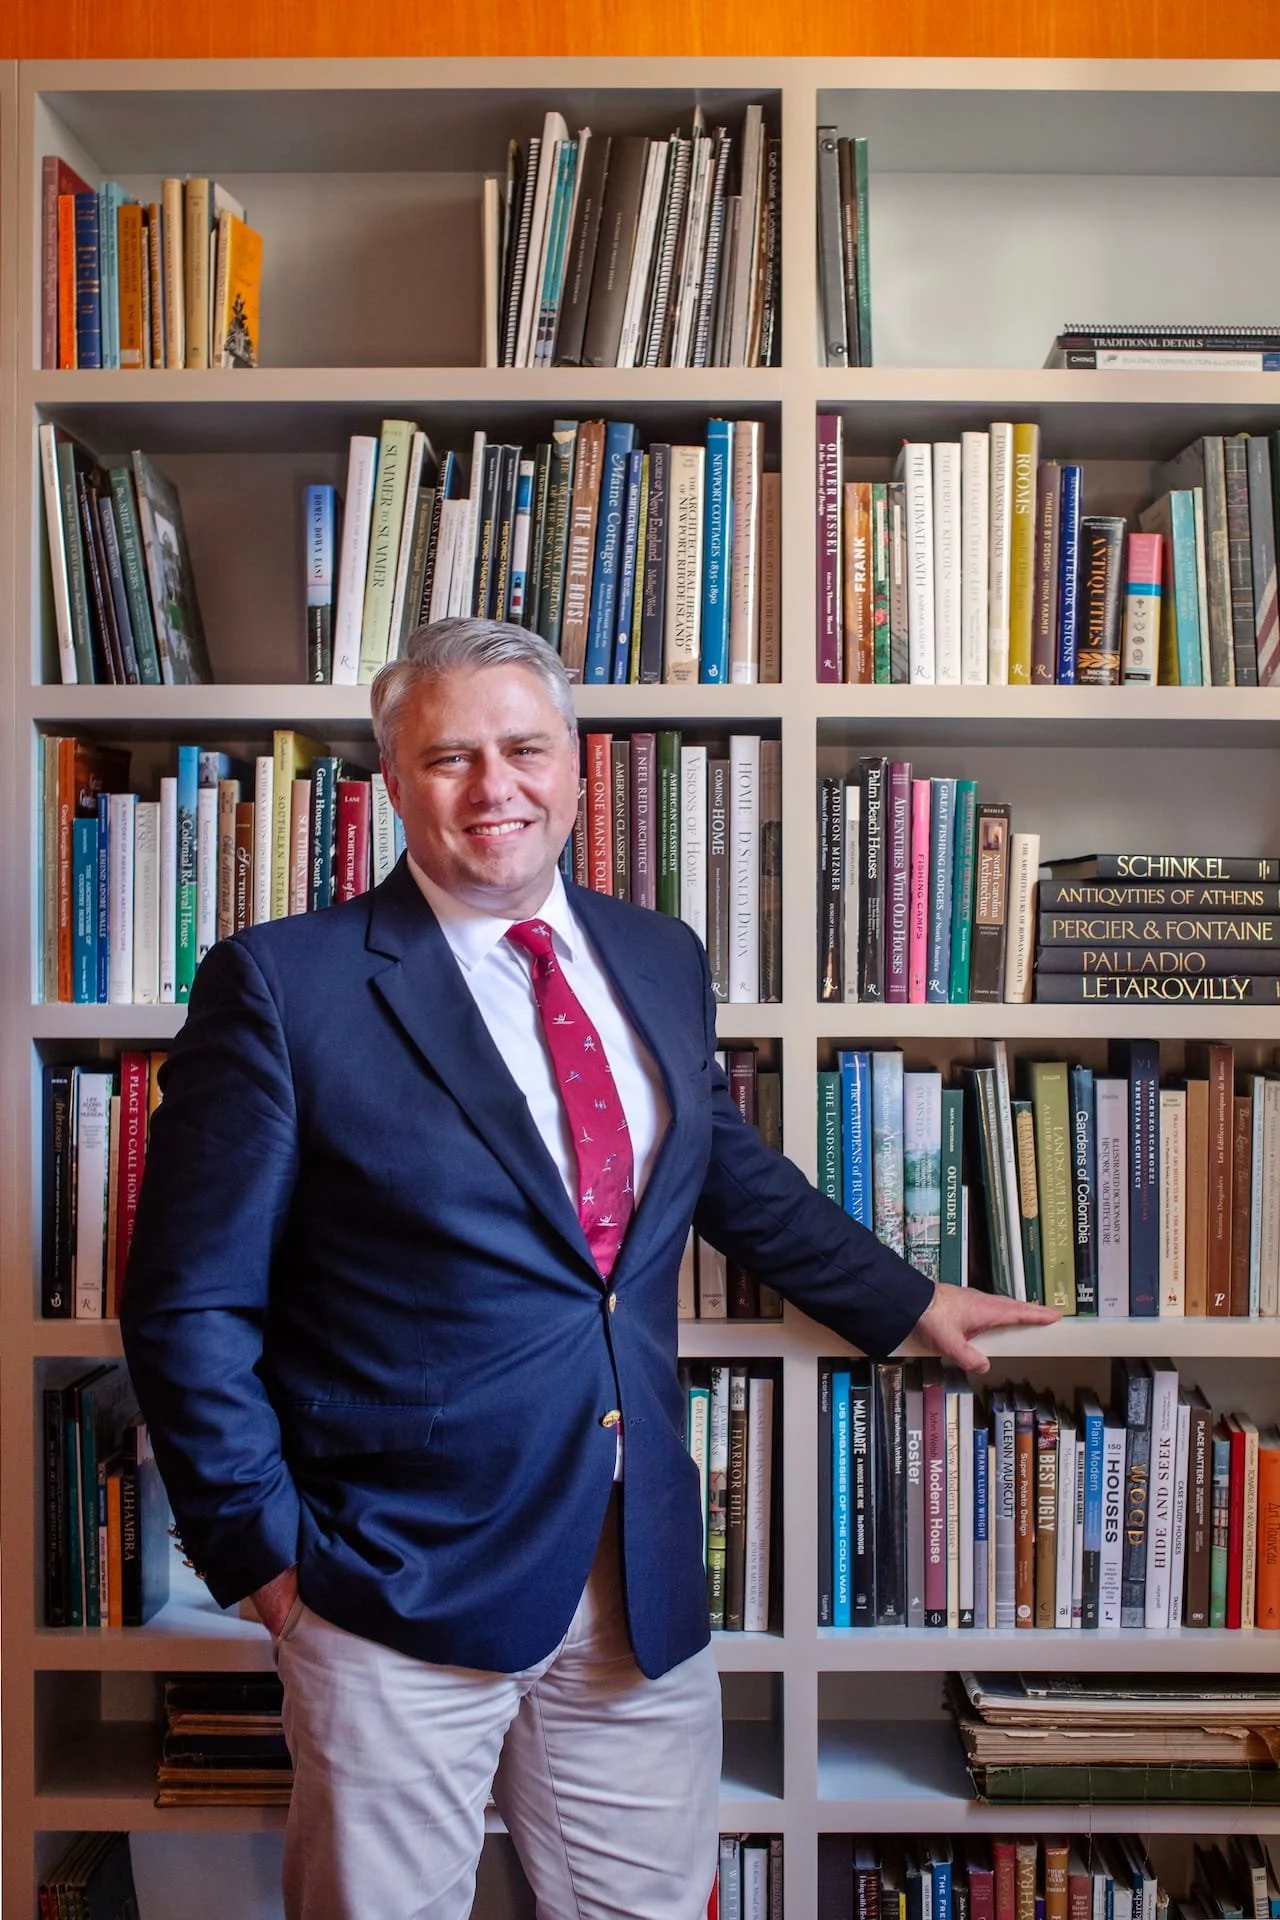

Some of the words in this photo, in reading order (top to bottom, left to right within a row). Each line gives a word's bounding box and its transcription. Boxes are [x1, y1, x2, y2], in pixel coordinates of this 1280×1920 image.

[1092, 338, 1160, 347] TRADITIONAL
[1162, 339, 1204, 348] DETAILS
[380, 444, 397, 506] SUMMER
[608, 453, 626, 506] Maine
[712, 454, 722, 502] NEWPORT
[826, 444, 837, 496] OLIVER
[1016, 453, 1031, 514] ROOMS
[314, 494, 324, 522] HOMES
[574, 506, 592, 528] THE
[1044, 492, 1052, 527] TIMELESS
[314, 527, 323, 553] DOWN
[501, 520, 510, 558] HISTORIC
[600, 512, 619, 574] Cottages
[677, 498, 688, 558] NEWPORT,
[687, 494, 698, 593] ARCHITECTURAL
[710, 504, 721, 556] COTTAGES
[826, 503, 837, 556] MESSEL
[1044, 530, 1052, 541] BY
[314, 558, 322, 579] EAST
[372, 525, 391, 587] SUMMER
[498, 560, 507, 589] MAINE
[571, 536, 590, 576] MAINE
[854, 537, 865, 592] FRANK
[1043, 543, 1051, 572] DESIGN
[1064, 540, 1076, 605] INTERIOR
[677, 559, 686, 600] RHODE
[710, 560, 719, 604] 1835-1890
[1041, 579, 1050, 601] NINA
[1087, 538, 1106, 645] ANTIQUITIES
[566, 584, 585, 624] HOUSE
[675, 603, 685, 647] ISLAND
[685, 596, 695, 653] HERITAGE
[1063, 609, 1075, 662] VISIONS
[316, 768, 326, 797] Great
[616, 762, 624, 817] AMERICAN
[638, 757, 647, 785] NEEL
[714, 769, 723, 806] COMING
[737, 762, 752, 813] HOME
[867, 769, 880, 799] Palm
[594, 782, 605, 811] ONE
[637, 788, 647, 815] REID,
[832, 787, 840, 841] ADDISON
[939, 786, 948, 819] GREAT
[315, 800, 325, 836] Houses
[594, 815, 605, 856] MAN'S
[712, 809, 725, 855] HOME
[739, 832, 752, 843] D.
[868, 801, 880, 835] Beach
[893, 796, 906, 867] ADVENTURES
[181, 820, 192, 866] Colonial
[616, 819, 625, 875] CLASSICIST
[868, 837, 880, 878] Houses
[938, 824, 947, 866] FISHING
[313, 858, 324, 887] South
[738, 845, 751, 906] STANLEY
[831, 846, 840, 891] MIZNER
[893, 872, 906, 901] WITH
[980, 854, 992, 916] Architecture
[992, 854, 1002, 880] North
[1117, 856, 1230, 879] SCHINKEL
[181, 870, 192, 909] Revival
[936, 868, 945, 910] LODGES
[1057, 888, 1164, 905] ANTIQVITIES
[1171, 890, 1194, 904] OF
[1200, 890, 1263, 905] ATHENS
[180, 912, 191, 947] House
[893, 903, 906, 927] OLD
[1053, 920, 1140, 939] PERCIER
[1144, 921, 1162, 939] &
[1166, 921, 1273, 941] FONTAINE
[737, 912, 751, 958] DIXON
[893, 930, 906, 974] HOUSES
[1083, 952, 1206, 972] PALLADIO
[1082, 977, 1250, 1000] LETAROVILLY
[131, 1064, 138, 1072] A
[130, 1076, 138, 1113] PLACE
[826, 1084, 834, 1107] THE
[850, 1082, 860, 1103] The
[129, 1118, 137, 1135] TO
[826, 1112, 835, 1180] LANDSCAPE
[851, 1104, 862, 1163] GARDENS
[1077, 1111, 1089, 1164] Gardens
[128, 1138, 138, 1169] CALL
[852, 1166, 862, 1178] of
[127, 1173, 137, 1211] HOME
[946, 1166, 956, 1219] OUTSIDE
[1078, 1168, 1089, 1181] of
[946, 1222, 956, 1235] IN
[1078, 1185, 1090, 1243] Colombia
[839, 1402, 846, 1418] US
[853, 1400, 866, 1454] MALAPARTE
[1003, 1420, 1013, 1459] GLENN
[1091, 1421, 1101, 1447] Plain
[1196, 1421, 1205, 1447] PLACE
[731, 1430, 742, 1488] HARBOR
[908, 1430, 922, 1484] Foster
[1019, 1453, 1028, 1478] Super
[1039, 1455, 1055, 1492] BEST
[1090, 1450, 1100, 1491] Modern
[1159, 1438, 1170, 1480] SEEK
[1196, 1448, 1205, 1484] MATTERS
[839, 1496, 846, 1511] OF
[930, 1459, 942, 1514] Modern
[1003, 1462, 1013, 1518] MURCUTT
[1106, 1460, 1120, 1543] HOUSES
[1128, 1464, 1147, 1546] WOOD
[1156, 1487, 1168, 1520] AND
[123, 1482, 134, 1560] ALHAMBRA
[730, 1494, 741, 1528] HILL
[1019, 1509, 1028, 1536] Design
[1038, 1496, 1054, 1531] UGLY
[930, 1518, 942, 1563] House
[1154, 1529, 1167, 1568] HIDE
